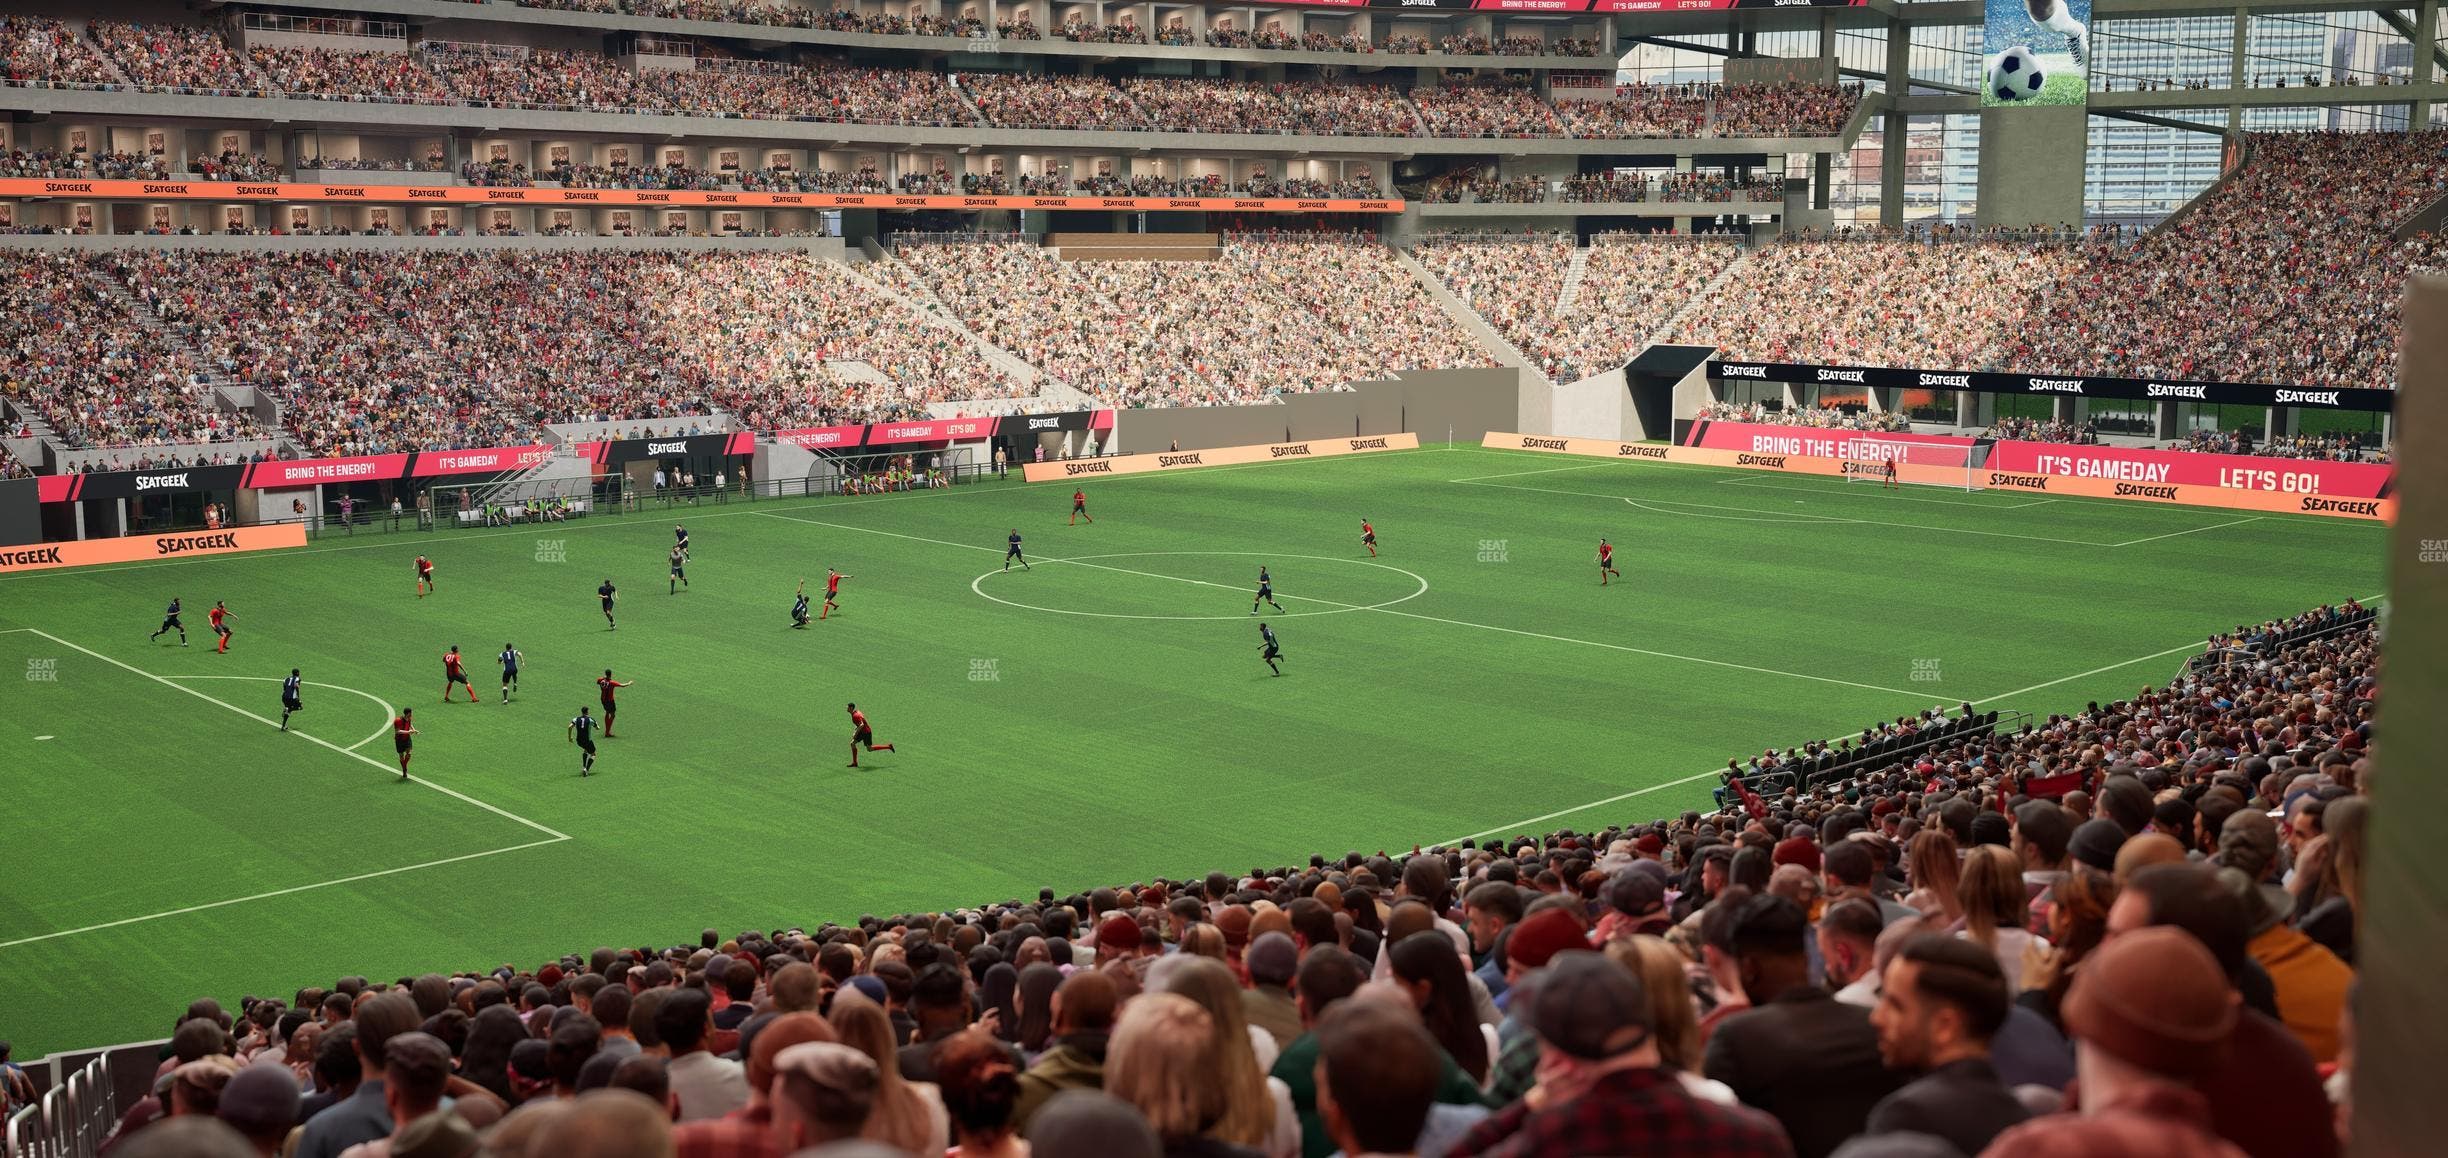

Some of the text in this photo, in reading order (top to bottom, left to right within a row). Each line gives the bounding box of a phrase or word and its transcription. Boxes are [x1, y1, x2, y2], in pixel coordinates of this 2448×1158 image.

[1538, 1, 1566, 9] ENERGY!
[1627, 2, 1661, 10] GAMEDAY
[1677, 1, 1696, 9] LET'S
[45, 182, 93, 193] SEATGEEK
[143, 184, 188, 195] SEATGEEK
[236, 185, 279, 196] SEATGEEK
[324, 187, 365, 197] SEATGEEK
[408, 189, 447, 199] SEATGEEK
[488, 190, 525, 200] SEATGEEK
[564, 191, 599, 201] SEATGEEK
[636, 192, 670, 202] SEATGEEK
[705, 194, 738, 203] SEATGEEK
[771, 195, 803, 204] SEATGEEK
[835, 196, 865, 205] SEATGEEK
[895, 197, 927, 206] SEATGEEK
[964, 198, 998, 206] SEATGEEK
[1034, 199, 1067, 207] SEATGEEK
[1102, 199, 1135, 207] SEATGEEK
[1169, 200, 1201, 208] SEATGEEK
[1234, 200, 1265, 208] SEATGEEK
[1297, 201, 1328, 209] SEATGEEK
[1359, 201, 1389, 209] SEATGEEK
[1723, 365, 1766, 378] SEATGEEK
[1818, 369, 1864, 382] SEATGEEK
[1920, 374, 1969, 387] SEATGEEK
[2029, 379, 2083, 393] SEATGEEK
[2147, 383, 2206, 398] SEATGEEK
[2275, 389, 2339, 405] SEATGEEK
[947, 424, 976, 434] LET'S GO!
[1029, 417, 1059, 429] SEATGEEK
[811, 433, 841, 444] ENERGY!
[888, 427, 933, 438] IT'S GAMEDAY
[648, 441, 687, 456] SEATGEEK
[1350, 437, 1388, 451] SEATGEEK
[1522, 437, 1568, 451] SEATGEEK
[1753, 435, 1907, 464] BRING THE ENERGY!
[1271, 444, 1310, 457] SEATGEEK
[1619, 444, 1668, 459] SEATGEEK
[439, 455, 498, 469] IT'S GAMEDAY
[1159, 453, 1202, 468] SEATGEEK
[1736, 453, 1785, 469] SEATGEEK
[285, 463, 376, 480] BRING THE ENERGY!
[1065, 460, 1112, 475] SEATGEEK
[1840, 461, 1890, 476] SEATGEE
[2037, 455, 2170, 483] IT'S GAMEDAY
[135, 472, 189, 491] SEATGEEK
[1989, 473, 2048, 490] SEATGEEK
[2219, 467, 2320, 494] LET'S GO!
[2114, 482, 2178, 500] SEATGEEK
[2301, 497, 2379, 517] SEATGEEK
[156, 532, 239, 555] SEATGEEK
